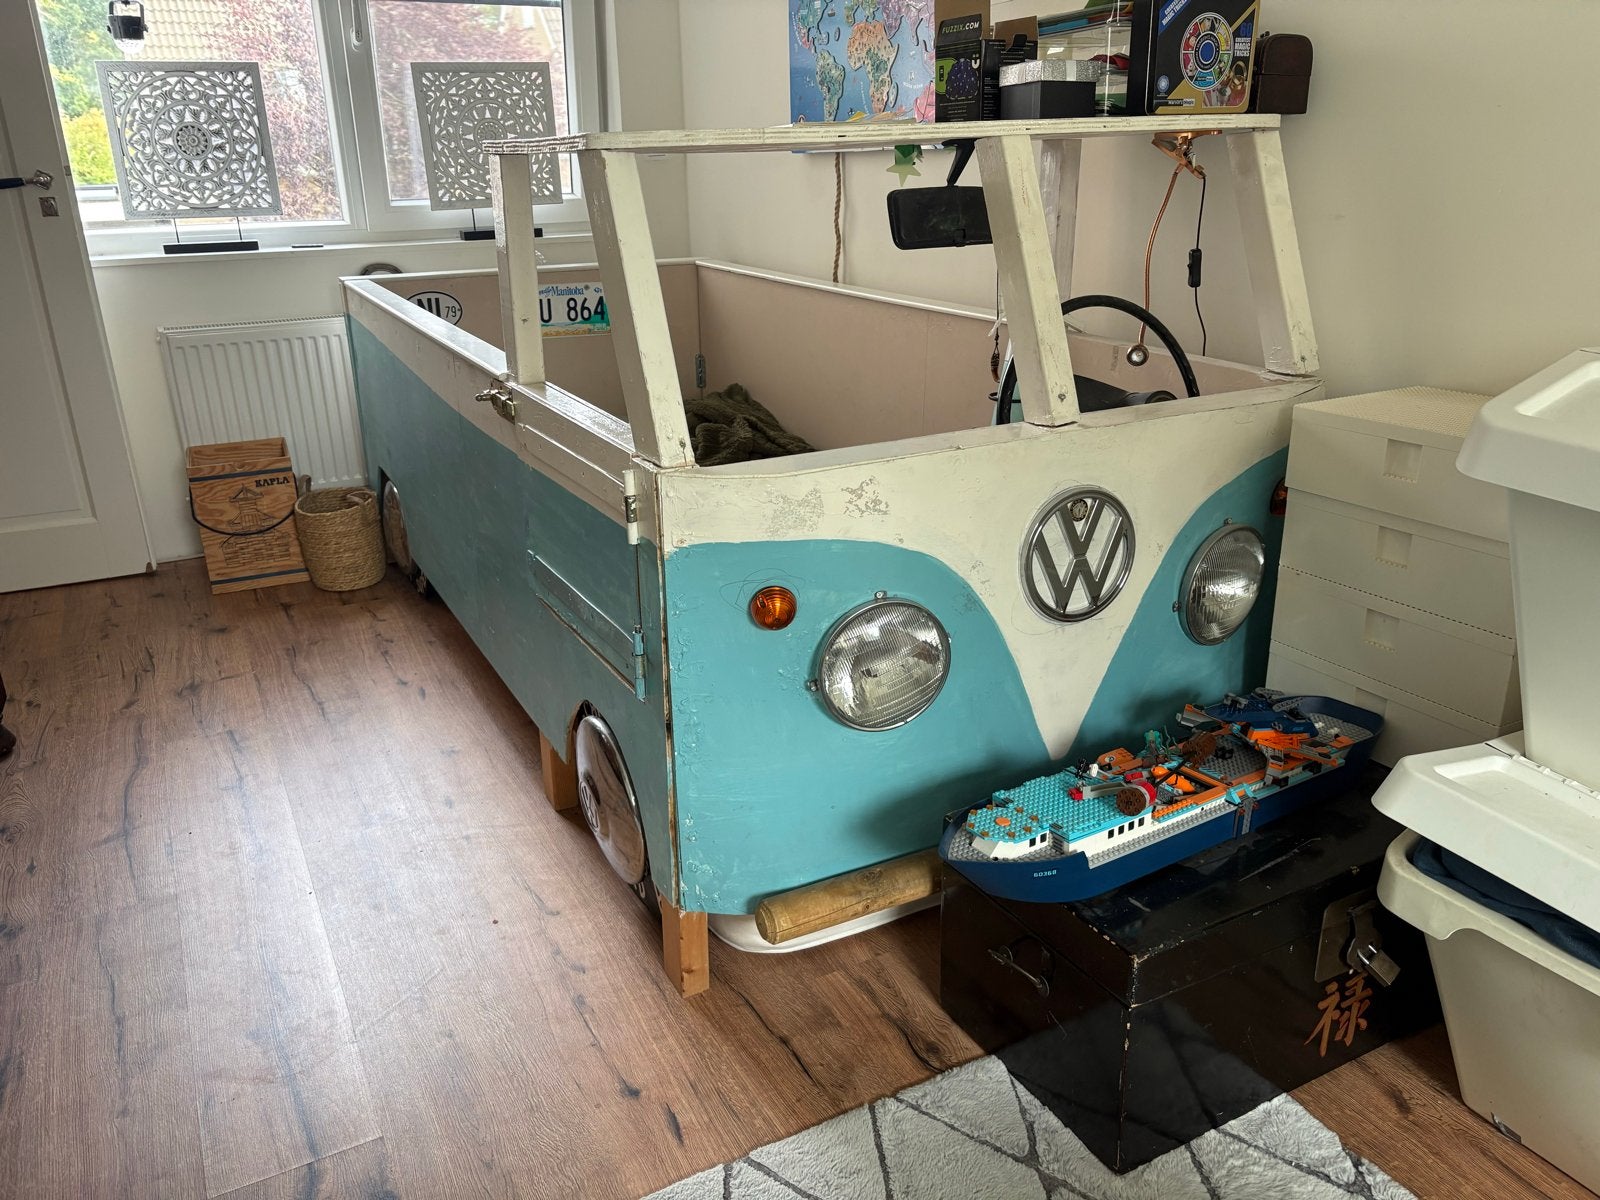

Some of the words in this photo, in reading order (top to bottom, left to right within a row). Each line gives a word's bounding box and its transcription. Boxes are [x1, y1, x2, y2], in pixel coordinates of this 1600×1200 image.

[1234, 42, 1250, 50] MAGIC
[551, 286, 584, 297] Manitoba
[445, 305, 457, 319] 79
[566, 296, 606, 322] 864
[255, 476, 290, 488] KAPLA
[1027, 493, 1128, 616] VW
[1033, 869, 1057, 878] 60368
